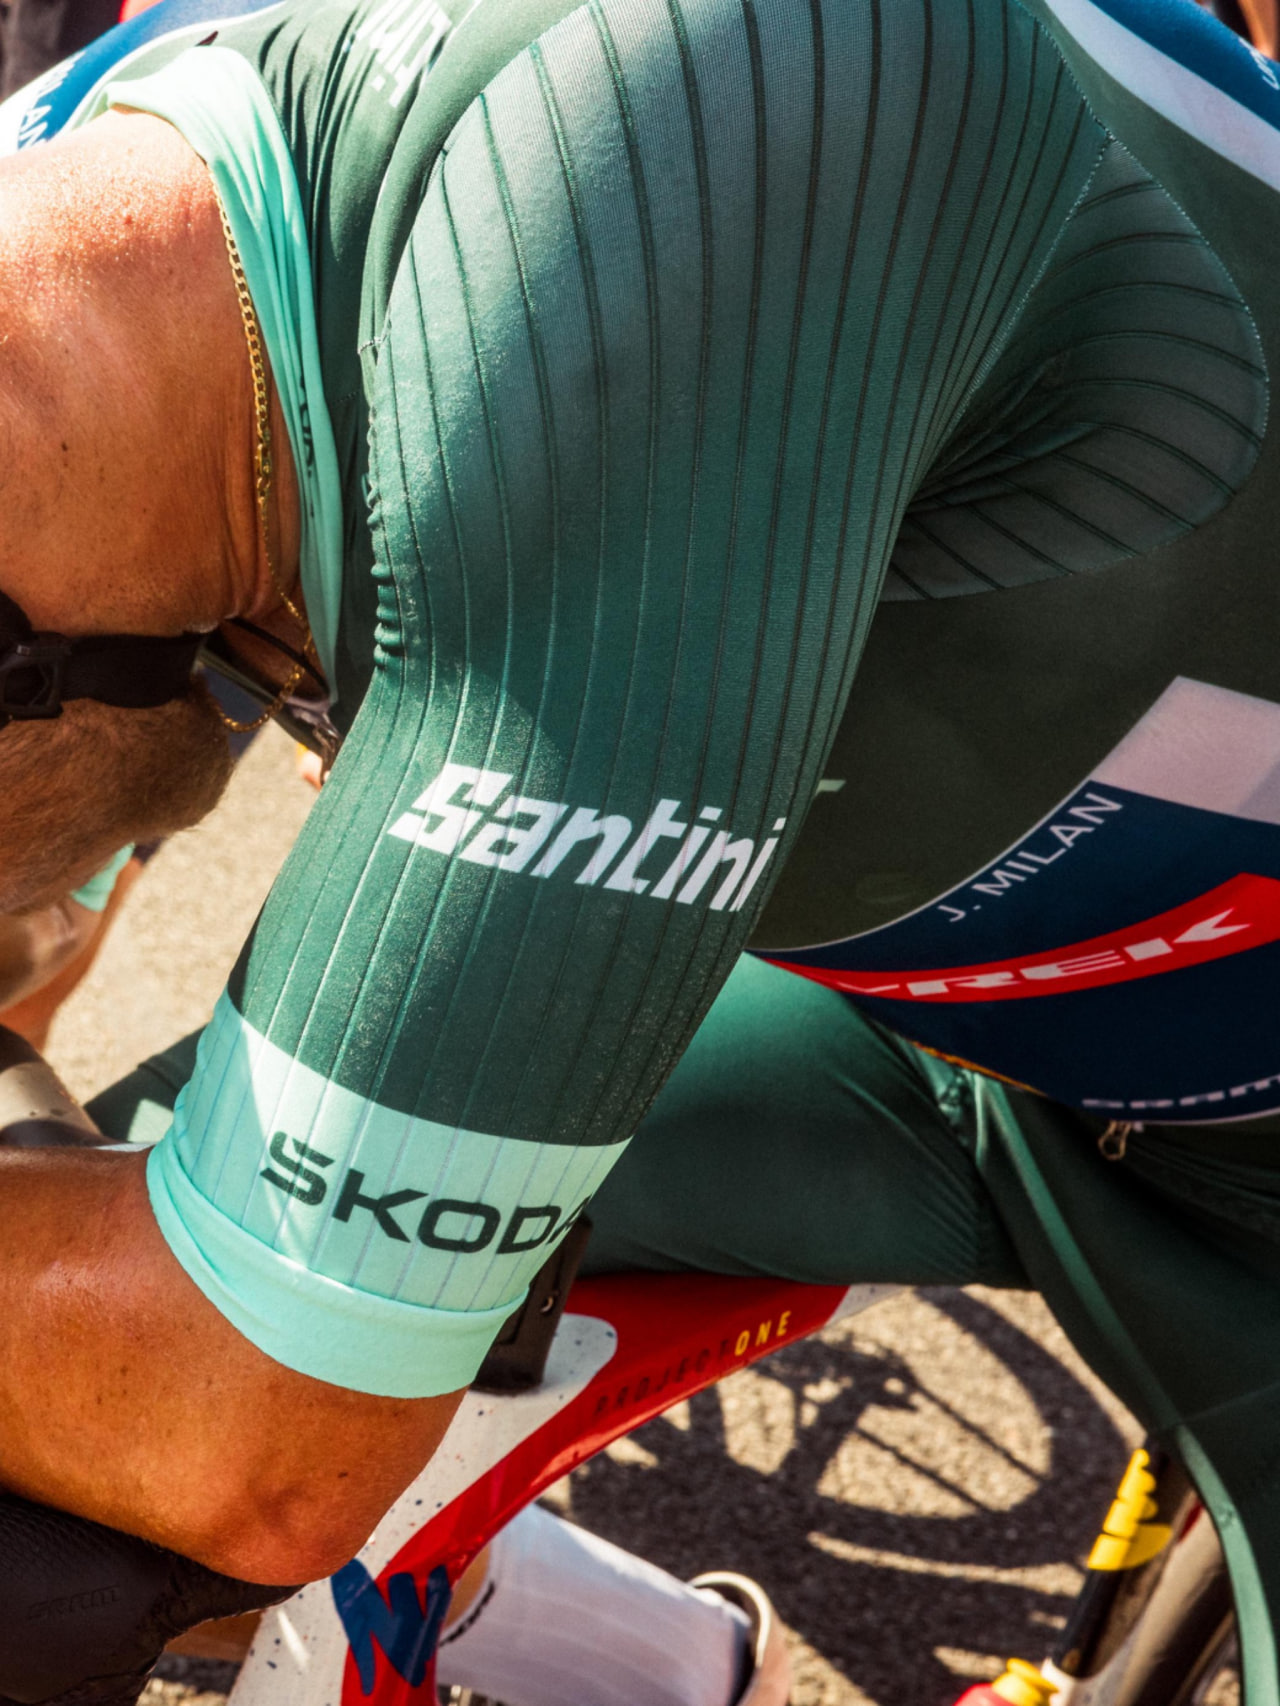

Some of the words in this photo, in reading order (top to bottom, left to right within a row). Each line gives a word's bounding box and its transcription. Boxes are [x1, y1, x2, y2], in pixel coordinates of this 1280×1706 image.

[387, 762, 786, 912] Santini
[937, 904, 982, 923] J.
[971, 792, 1124, 896] MILAN
